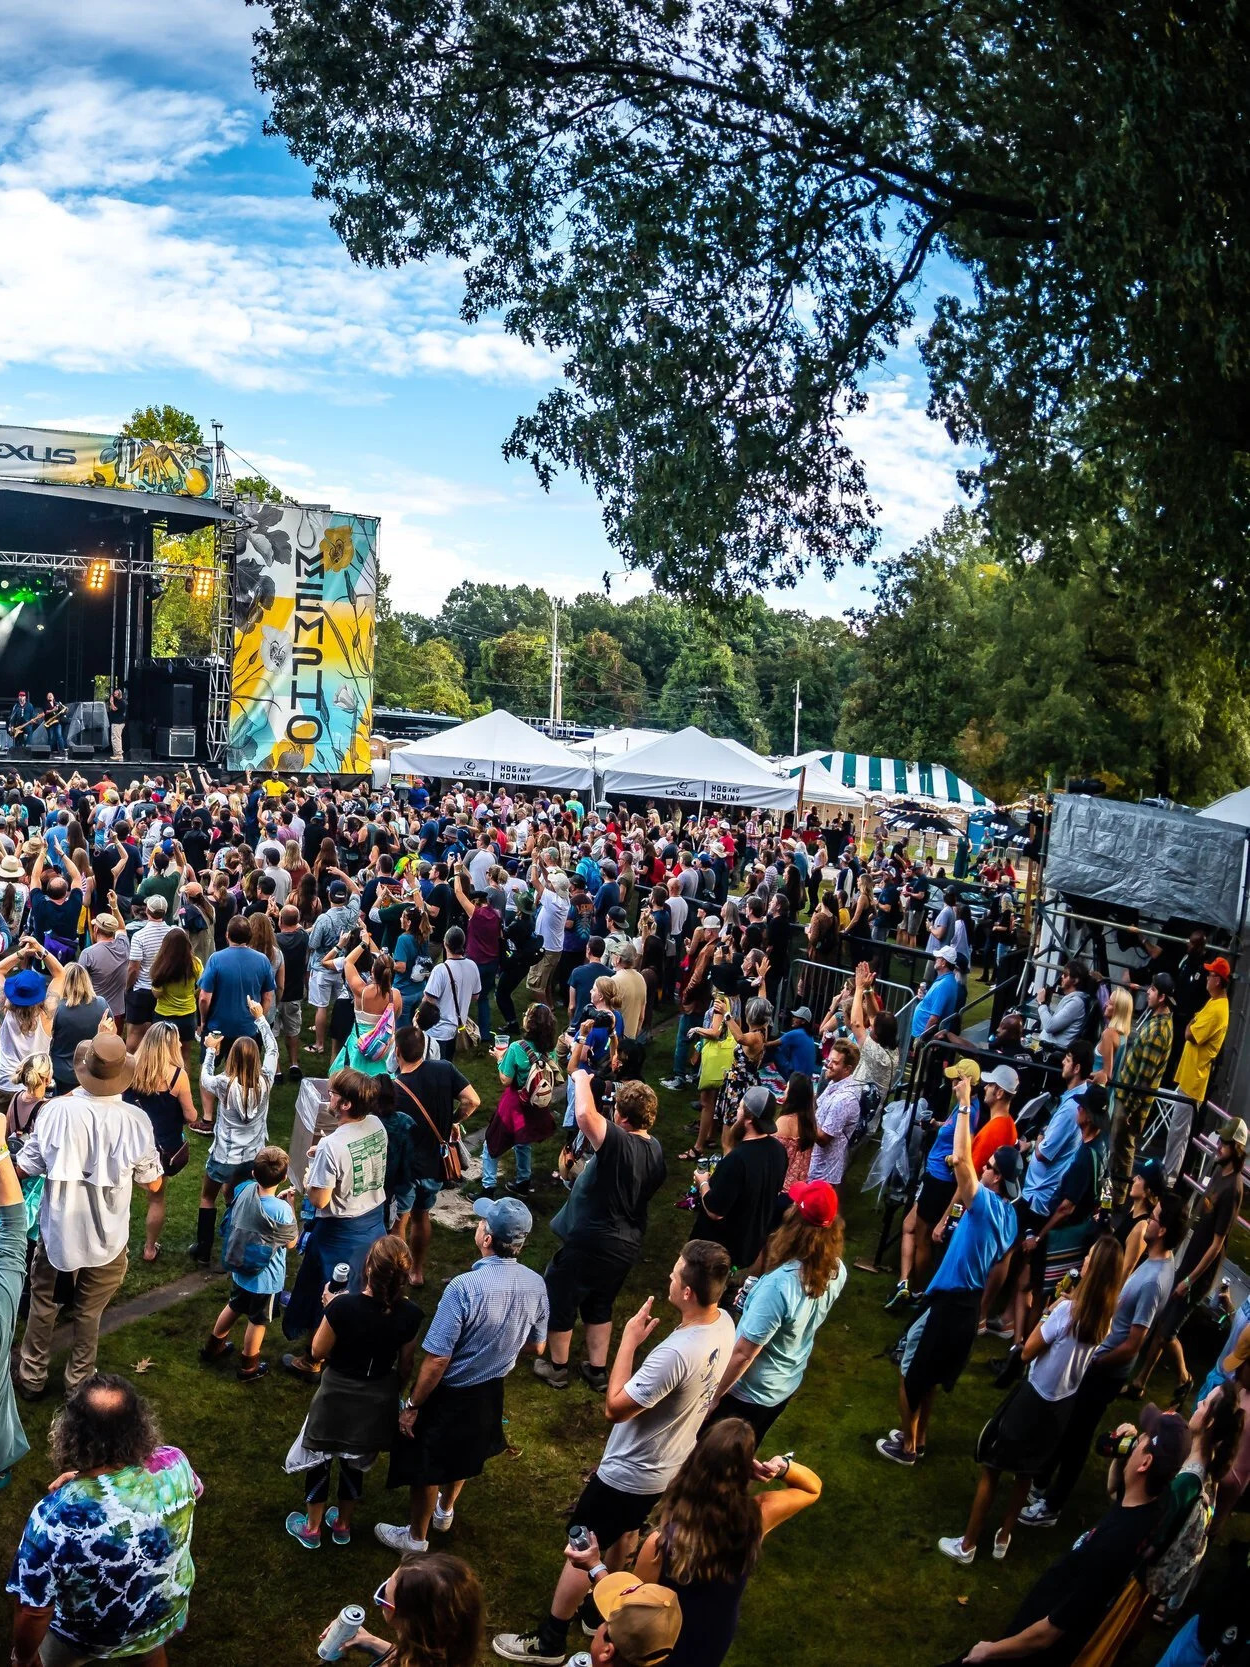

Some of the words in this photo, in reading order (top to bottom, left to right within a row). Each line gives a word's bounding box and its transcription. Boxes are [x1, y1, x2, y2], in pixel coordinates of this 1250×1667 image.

[285, 549, 326, 745] MEMPHO
[500, 764, 517, 773] HOG
[452, 770, 486, 778] LEXUS
[500, 772, 531, 782] HOMINY
[711, 784, 728, 793] HOG
[665, 789, 698, 798] LEXUS
[710, 792, 741, 802] HOMINY
